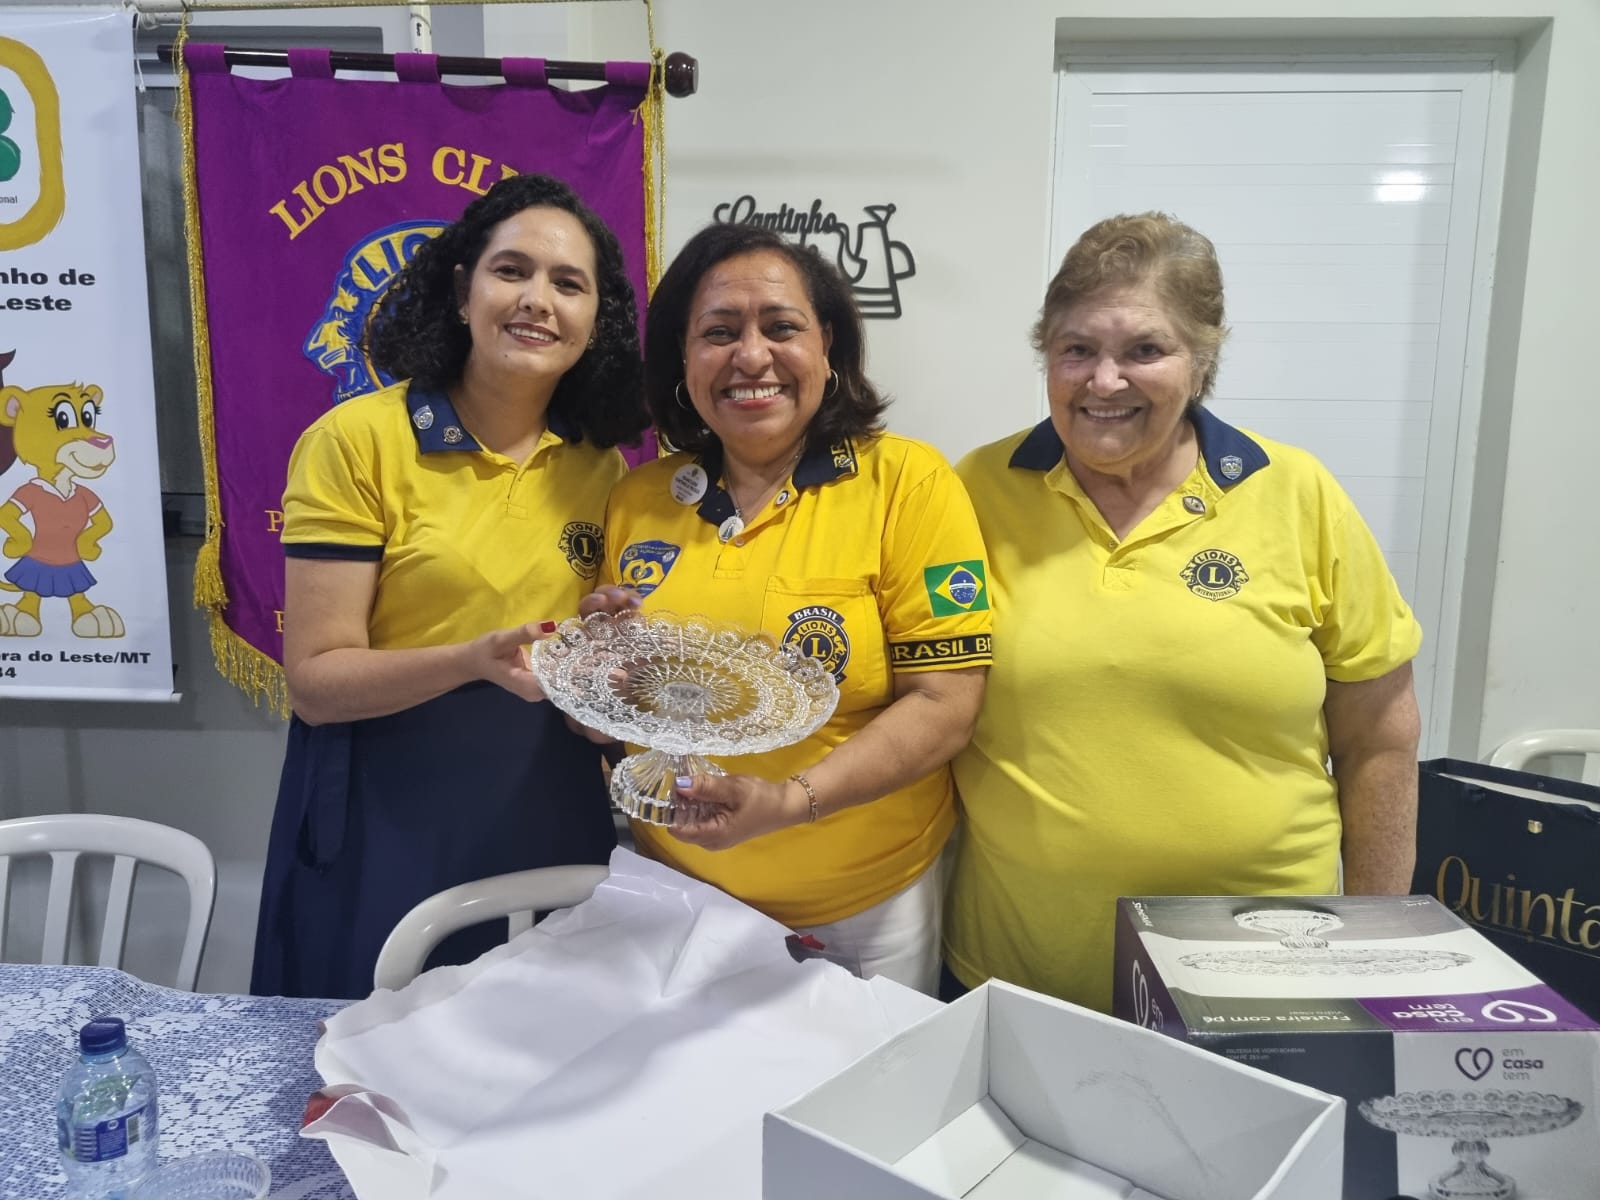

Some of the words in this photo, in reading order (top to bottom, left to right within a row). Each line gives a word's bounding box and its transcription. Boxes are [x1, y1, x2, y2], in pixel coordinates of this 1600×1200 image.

[269, 143, 407, 240] LIONS
[432, 146, 519, 196] CL
[58, 269, 96, 286] de
[0, 295, 72, 311] este
[567, 524, 601, 537] LIONS
[580, 538, 593, 558] L
[1198, 552, 1235, 565] LIONS
[1207, 566, 1225, 584] L
[793, 607, 839, 622] BRASIL
[800, 621, 834, 634] LIONS
[811, 637, 826, 657] L
[891, 639, 969, 660] RASIL
[0, 651, 21, 662] ra
[28, 650, 53, 662] do
[60, 651, 151, 663] Leste/MT
[1392, 1010, 1465, 1018] casa
[1502, 1048, 1525, 1057] em
[1503, 1059, 1544, 1069] casa
[1503, 1071, 1530, 1080] tem
